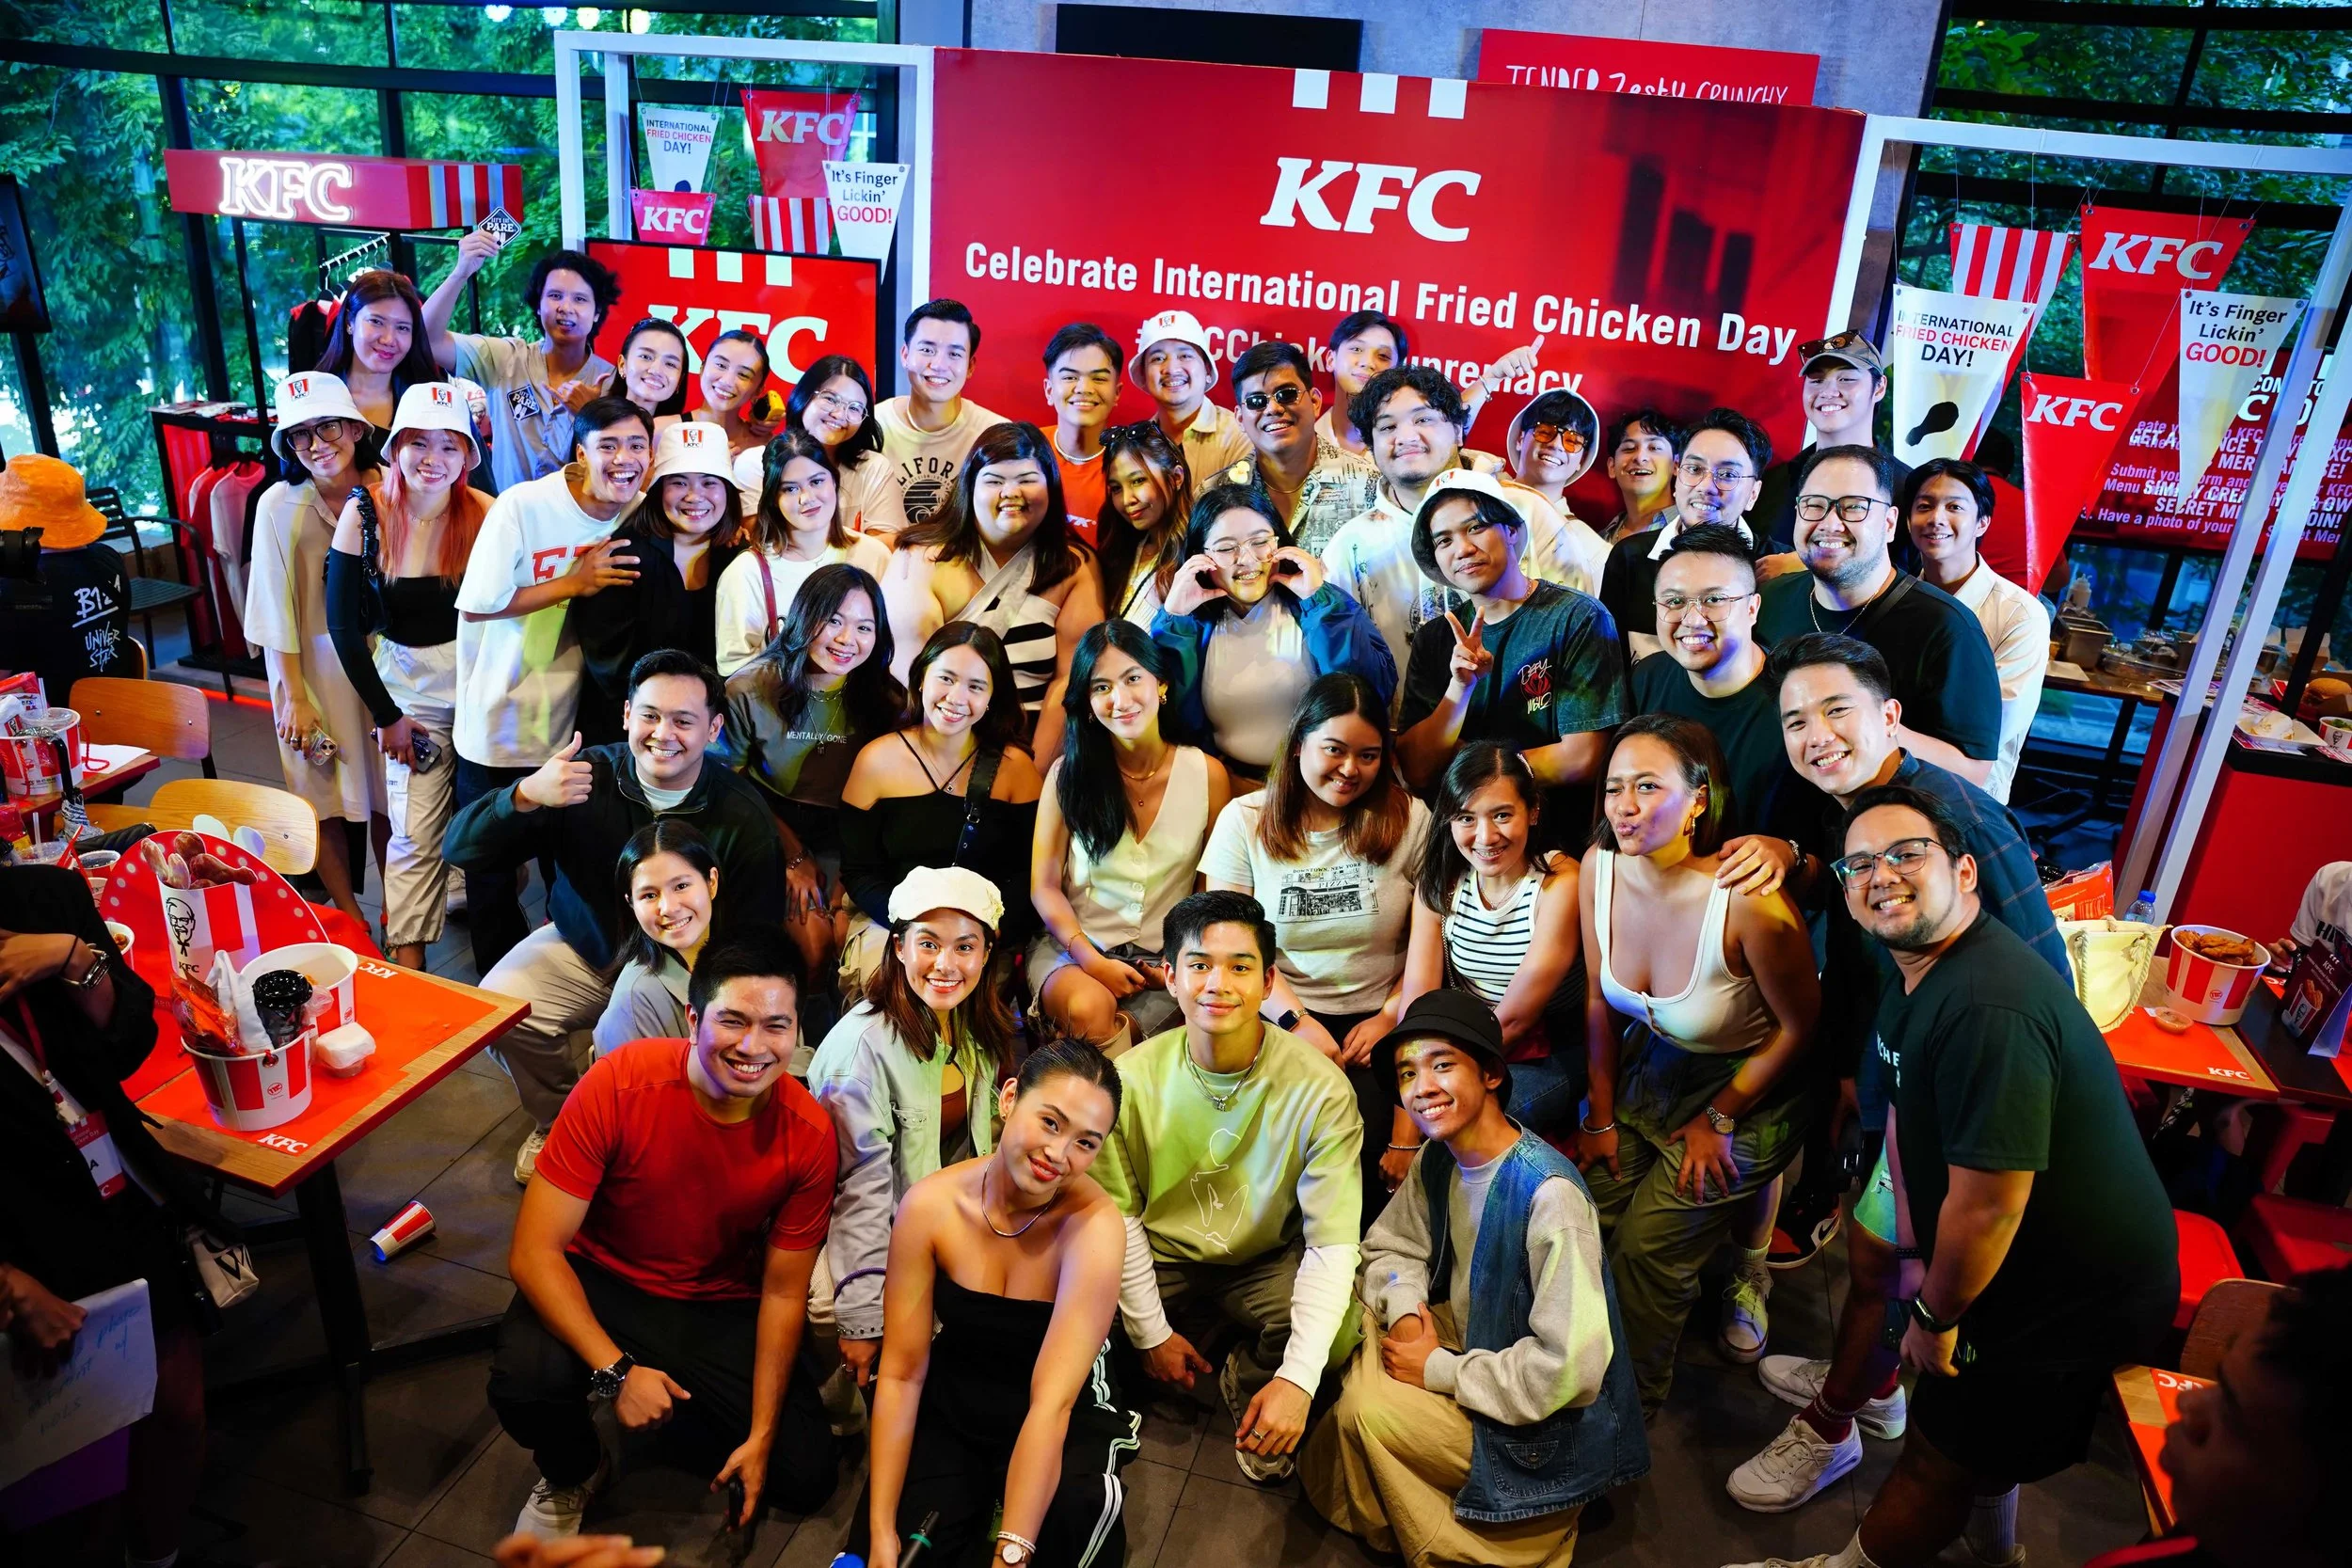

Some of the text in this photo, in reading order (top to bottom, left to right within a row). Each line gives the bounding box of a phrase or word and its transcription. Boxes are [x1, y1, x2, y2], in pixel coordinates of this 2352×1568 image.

[646, 119, 711, 134] INTERNATIONAL
[757, 110, 846, 146] KFC
[646, 130, 711, 143] FRIED CHICKEN
[663, 140, 691, 154] DAY!
[854, 171, 898, 188] Finger
[218, 156, 355, 222] KFC
[1260, 156, 1482, 243] KFC
[641, 206, 704, 234] KFC
[837, 205, 892, 224] GOOD!
[486, 222, 515, 232] PARE
[2090, 231, 2226, 280] KFC
[965, 242, 1798, 366] Celebrate International Fried Chicken Day
[2225, 304, 2288, 325] Finger
[1941, 331, 2012, 354] CHICKEN
[1921, 343, 1975, 368] DAY!
[2185, 341, 2267, 368] GOOD!
[513, 393, 537, 410] PARE
[2025, 393, 2122, 434] KFC
[2110, 463, 2156, 480] Submit
[2104, 478, 2141, 494] Menu
[2098, 507, 2130, 523] Have
[2134, 515, 2143, 525] a
[2145, 515, 2183, 529] photo
[2186, 517, 2201, 531] of
[787, 731, 848, 744] MENTALLY GONE
[1318, 879, 1349, 889] PIZZA
[178, 961, 199, 974] KFC
[358, 962, 399, 979] KFC
[2322, 960, 2335, 974] KFC
[2206, 1067, 2250, 1080] KFC
[258, 1132, 310, 1154] KFC
